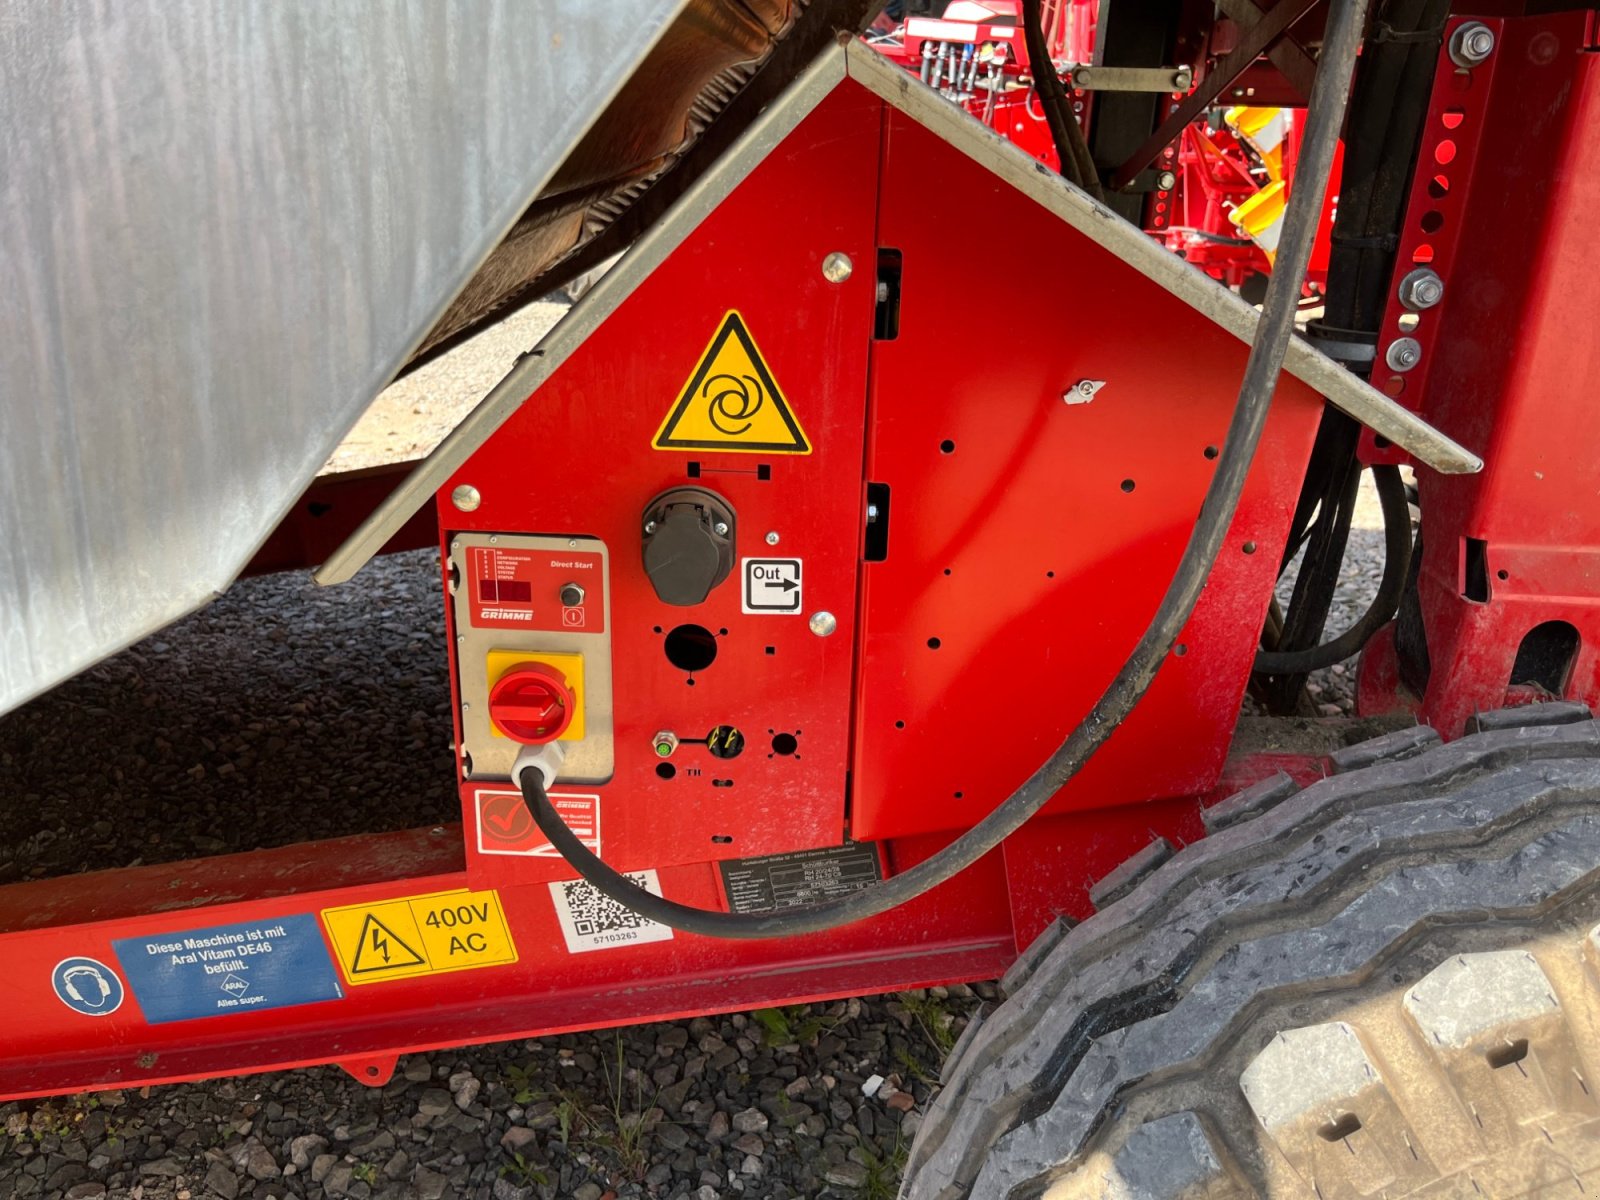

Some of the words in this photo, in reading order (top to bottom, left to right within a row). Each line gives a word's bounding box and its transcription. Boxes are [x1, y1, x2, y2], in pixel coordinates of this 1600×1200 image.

[550, 560, 574, 569] Direct
[574, 561, 593, 570] Start
[752, 566, 781, 581] Out
[480, 608, 534, 622] GRIMME
[424, 902, 490, 930] 400V
[146, 942, 183, 956] Diese
[184, 932, 245, 950] Maschine
[246, 929, 263, 942] ist
[264, 926, 287, 939] mit
[448, 933, 488, 956] AC
[593, 931, 638, 944] 57103263
[171, 954, 198, 966] Aral
[200, 948, 238, 962] Vitam
[238, 942, 272, 956] DE46
[204, 960, 249, 976] befüllt.
[224, 982, 246, 991] ARAL
[217, 998, 239, 1008] Alles
[239, 995, 268, 1006] super.
